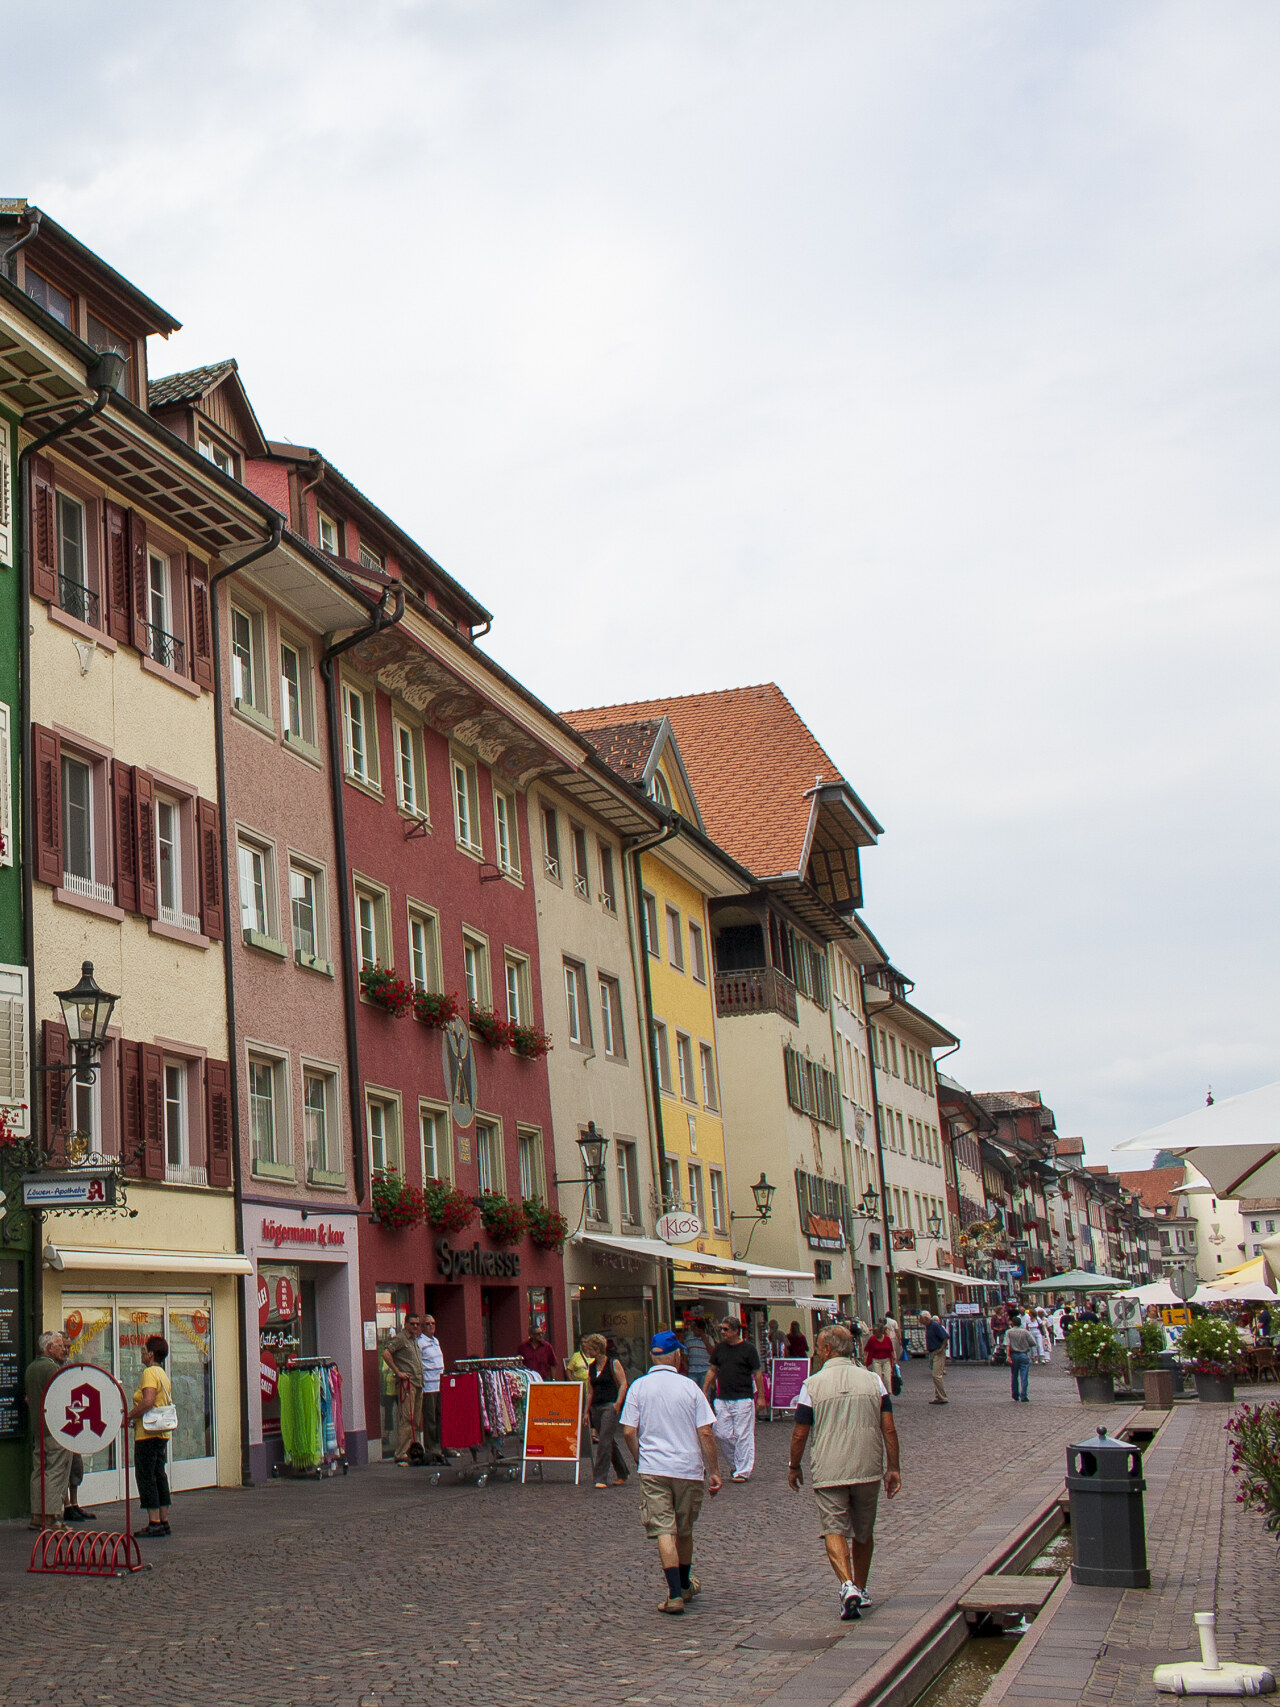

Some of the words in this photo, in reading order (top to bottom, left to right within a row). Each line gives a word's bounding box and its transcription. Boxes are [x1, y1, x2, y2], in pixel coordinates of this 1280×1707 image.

[261, 1218, 317, 1246] högermann
[318, 1222, 327, 1246] &
[328, 1223, 345, 1245] kox
[436, 1238, 521, 1282] Sparkasse
[60, 1382, 107, 1438] A
